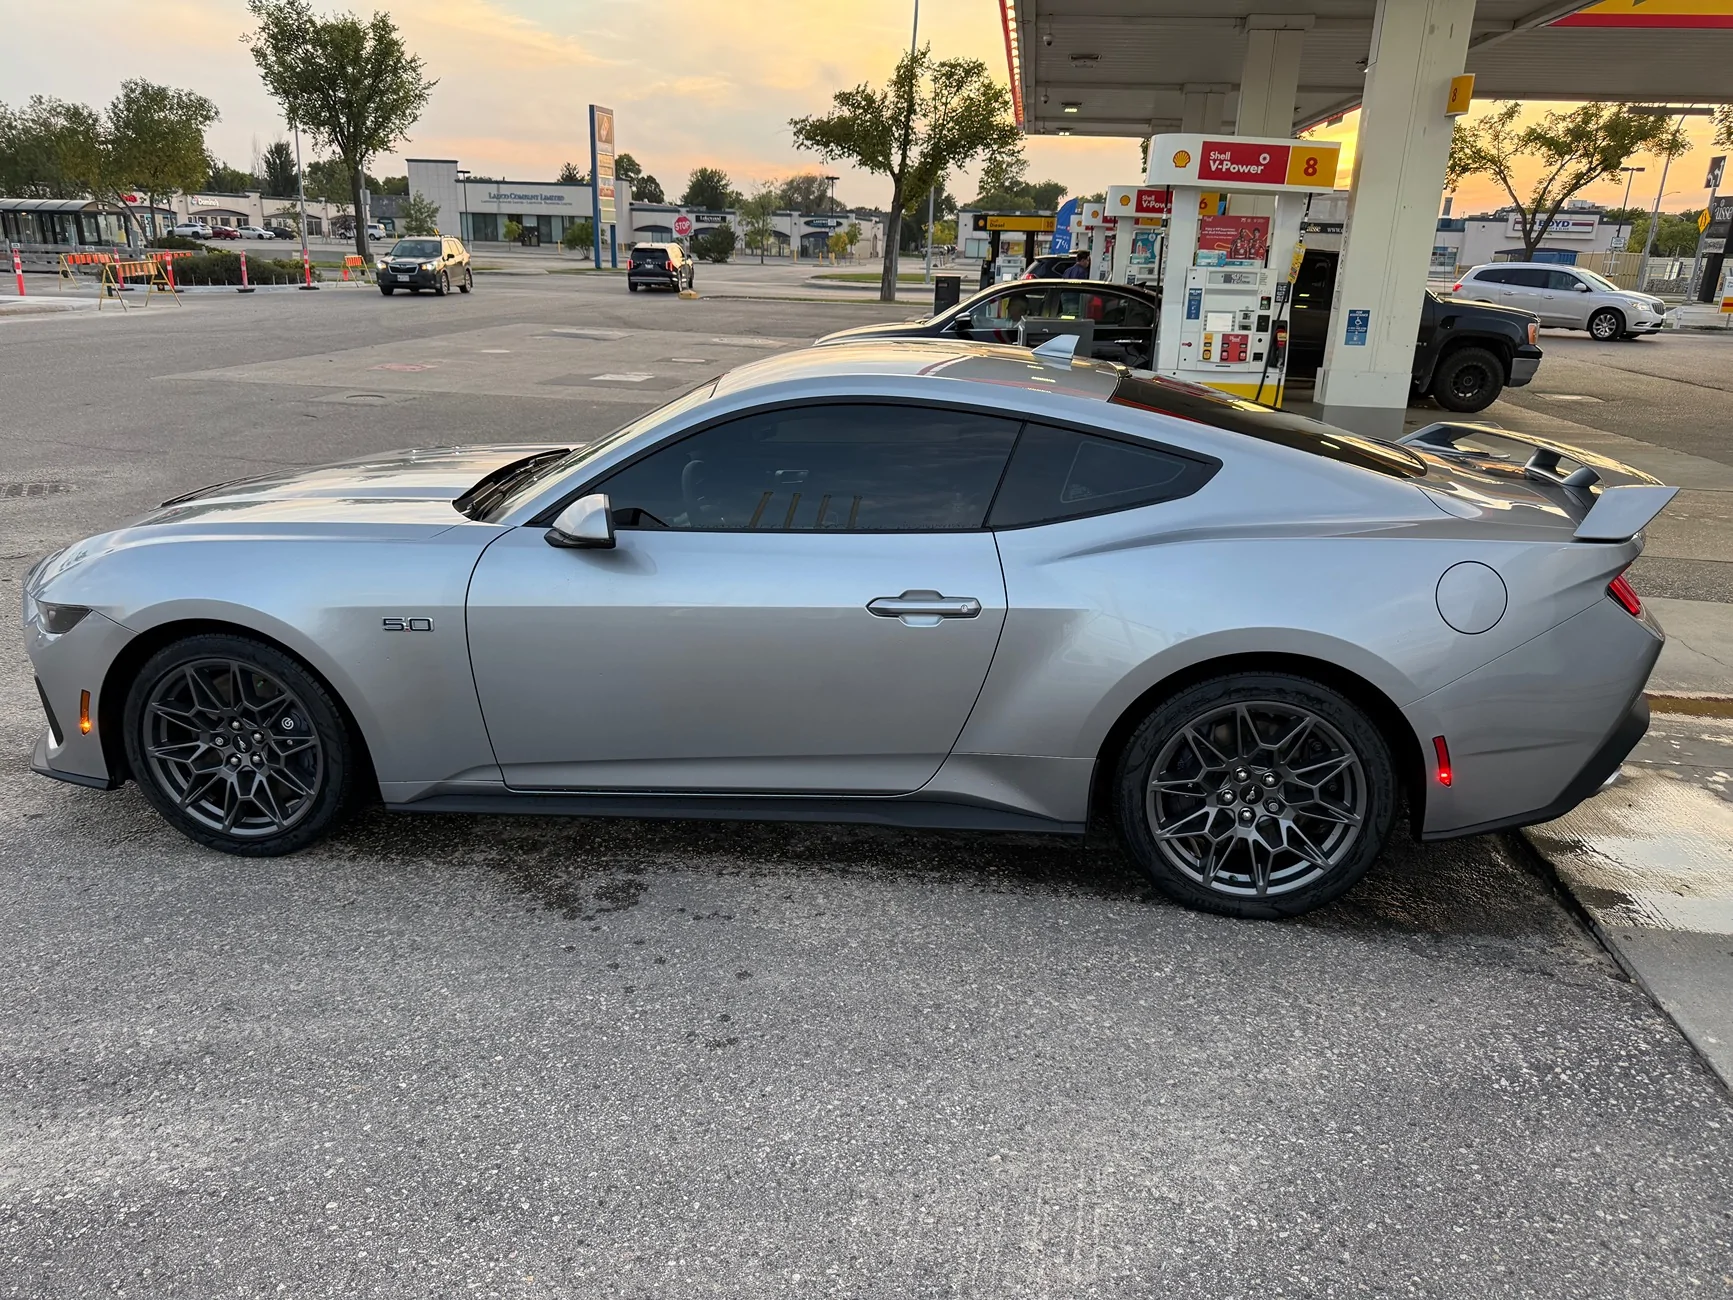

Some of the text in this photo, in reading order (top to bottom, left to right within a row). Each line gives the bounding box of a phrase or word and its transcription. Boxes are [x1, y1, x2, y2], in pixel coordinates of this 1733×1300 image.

[1451, 87, 1458, 103] 8
[1209, 151, 1231, 161] Shell
[1209, 160, 1264, 174] V-Power
[1303, 156, 1318, 177] 8
[198, 198, 219, 206] Domino's
[1142, 200, 1172, 209] V-Powe
[1199, 197, 1208, 210] 6
[675, 221, 691, 231] STOP
[382, 616, 434, 632] 5.0
